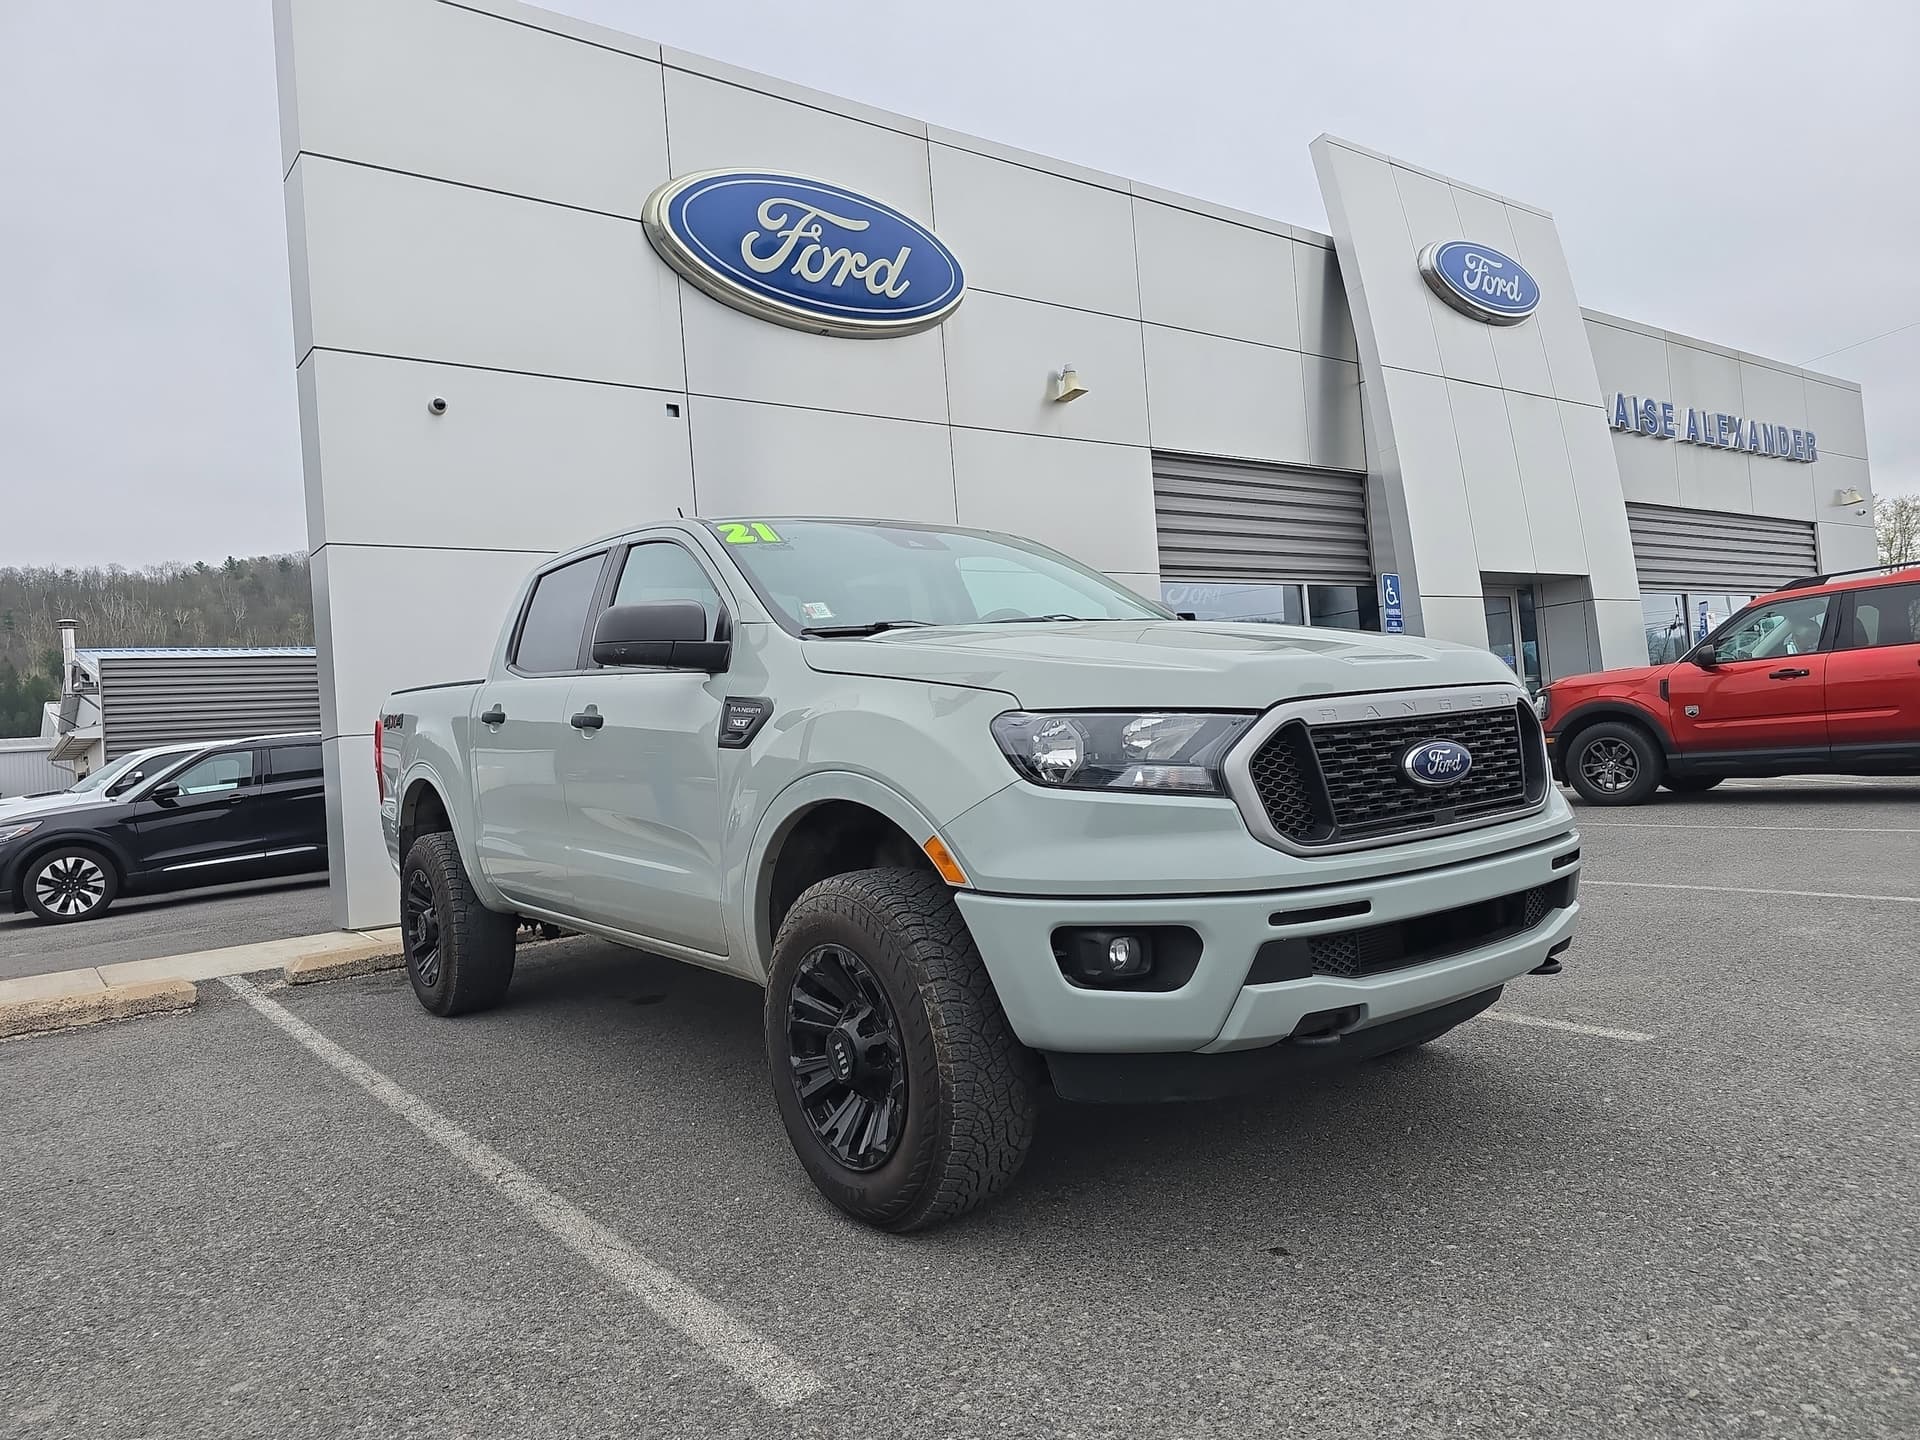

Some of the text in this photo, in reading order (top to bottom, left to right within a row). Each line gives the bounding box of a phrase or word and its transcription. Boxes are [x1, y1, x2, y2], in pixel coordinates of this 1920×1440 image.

[741, 198, 912, 299] Ford
[1463, 252, 1522, 302] Ford
[1609, 392, 1818, 462] AISE ALEXANDER
[717, 522, 783, 543] 21
[730, 706, 761, 714] RANGER
[1318, 693, 1511, 721] RANGER
[733, 719, 748, 727] XLT
[1427, 749, 1462, 775] Ford
